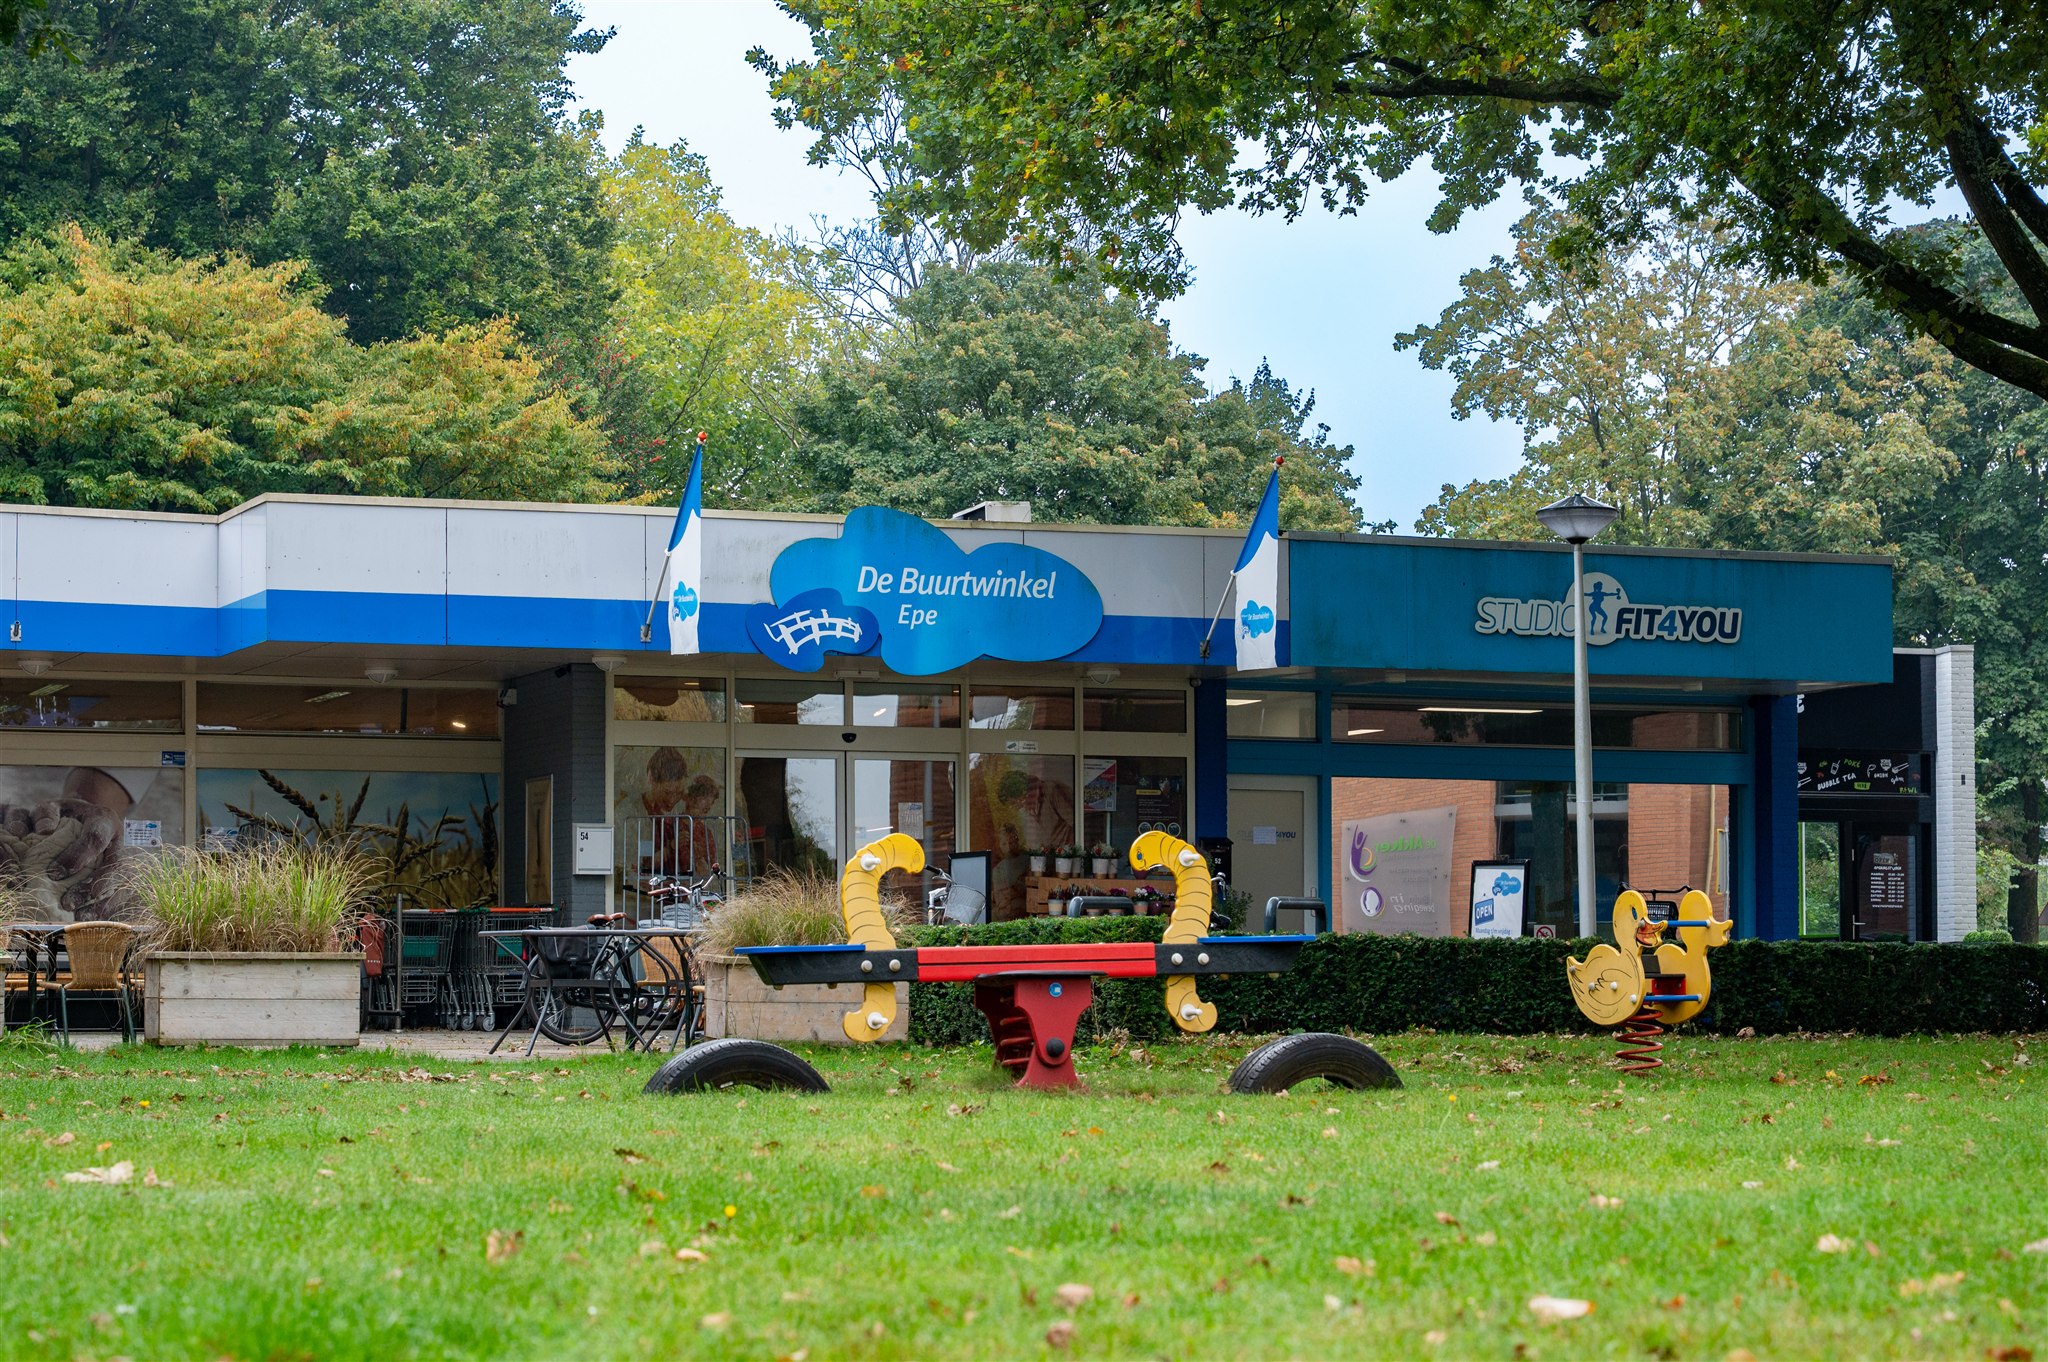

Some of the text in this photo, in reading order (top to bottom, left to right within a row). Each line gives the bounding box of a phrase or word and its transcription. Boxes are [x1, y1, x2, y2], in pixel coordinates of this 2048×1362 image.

[857, 565, 1057, 599] De Buurtwinkel
[897, 604, 938, 630] Epe
[1615, 607, 1740, 639] FIT4YOU
[1796, 694, 1805, 714] E
[1817, 777, 1840, 791] BUBBLE
[1842, 772, 1857, 782] TEA
[580, 831, 589, 841] 54
[1214, 857, 1222, 865] 52
[1475, 903, 1493, 919] OPEN
